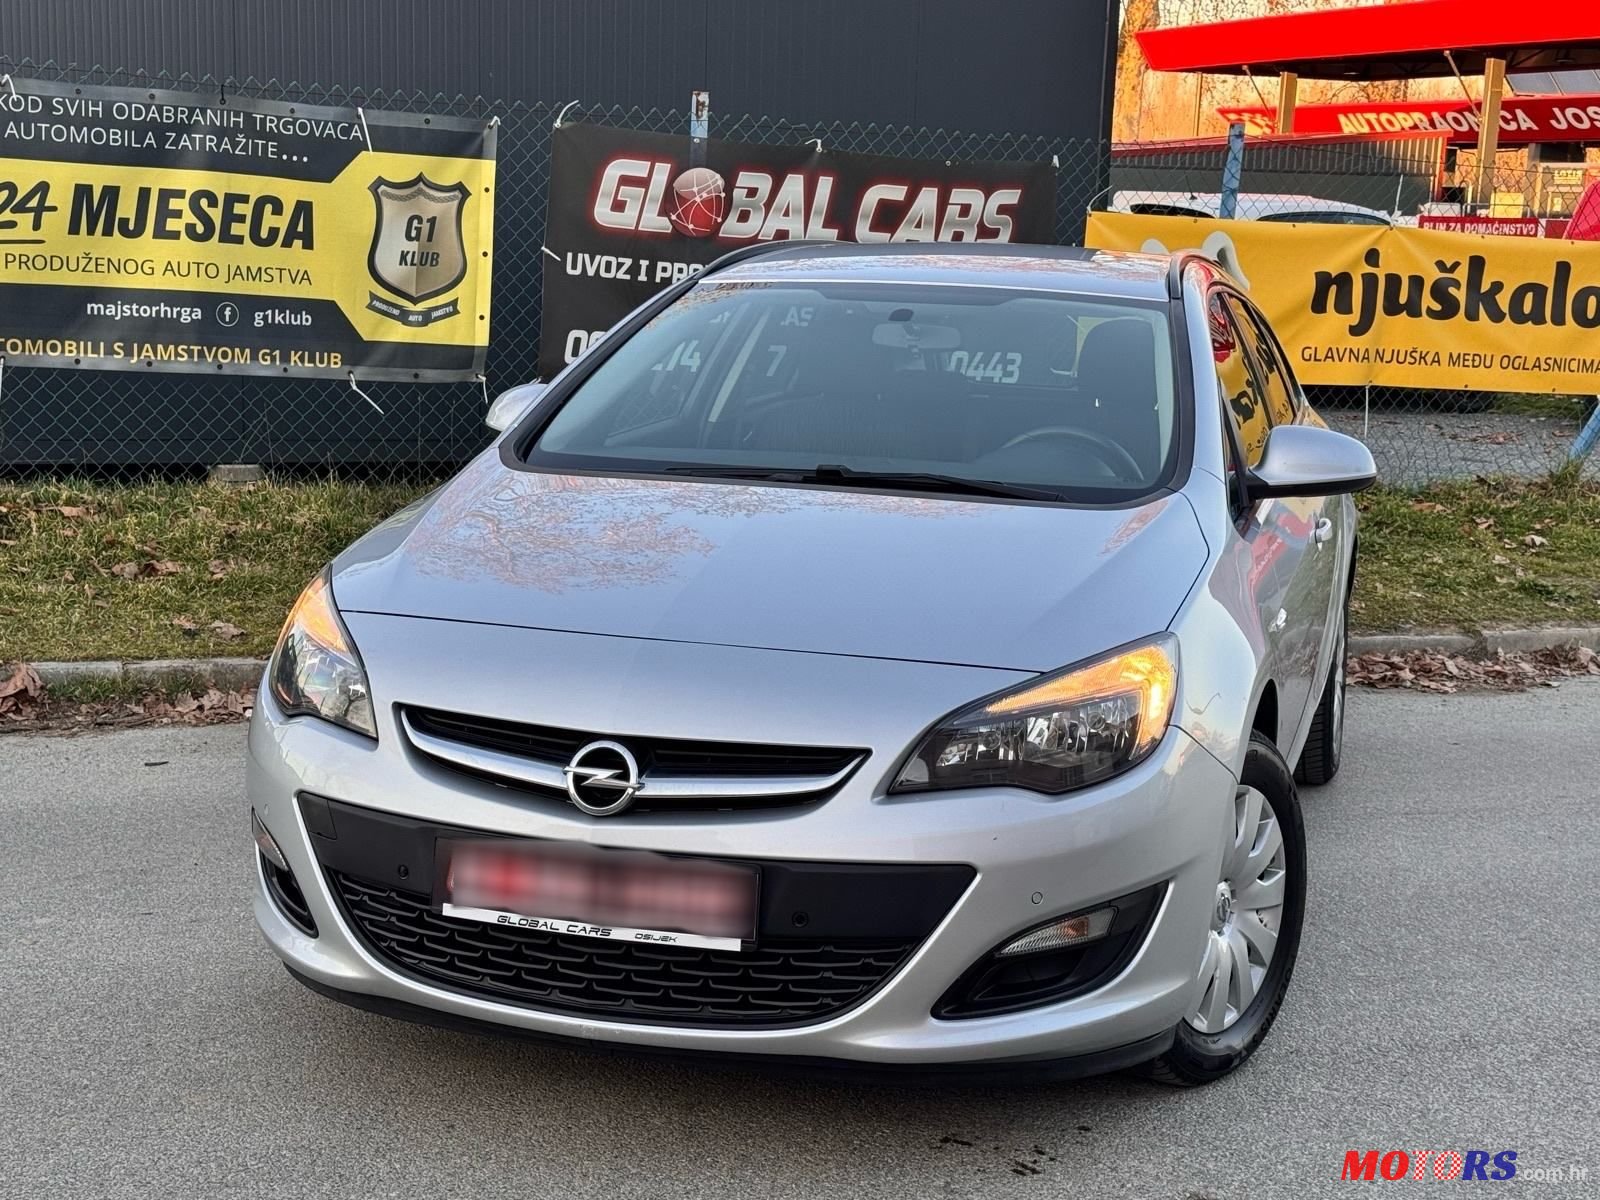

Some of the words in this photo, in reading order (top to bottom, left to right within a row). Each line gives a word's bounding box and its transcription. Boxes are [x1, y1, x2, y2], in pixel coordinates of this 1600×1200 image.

[51, 97, 103, 118] SVIH
[112, 102, 244, 129] ODABRANIH
[252, 114, 364, 142] TRGOVACA
[4, 121, 157, 149] AUTOMOBILA
[593, 158, 838, 241] GLOBAL
[854, 183, 1021, 243] CARS
[67, 183, 315, 250] MJESECA
[404, 214, 437, 243] G1
[4, 252, 155, 276] PRODUŽENOG
[162, 260, 220, 279] AUTO
[224, 263, 313, 286] JAMSTVA
[398, 249, 440, 267] KLUB
[566, 252, 633, 280] UVOZ
[638, 259, 650, 282] I
[1310, 247, 1600, 337] njuškalo
[86, 301, 202, 323] majstorhrga
[254, 309, 313, 328] g1klub
[113, 342, 125, 359] S
[130, 343, 251, 364] JAMSTVOM
[258, 350, 281, 366] G1
[290, 351, 342, 369] KLUB
[1301, 346, 1370, 363] GLAVNA
[1374, 347, 1441, 367] NJUŠKA
[1447, 352, 1494, 369] MEĐU
[496, 915, 560, 932] GLOBAL
[566, 924, 612, 937] CARS
[634, 932, 678, 943] OSIJEK
